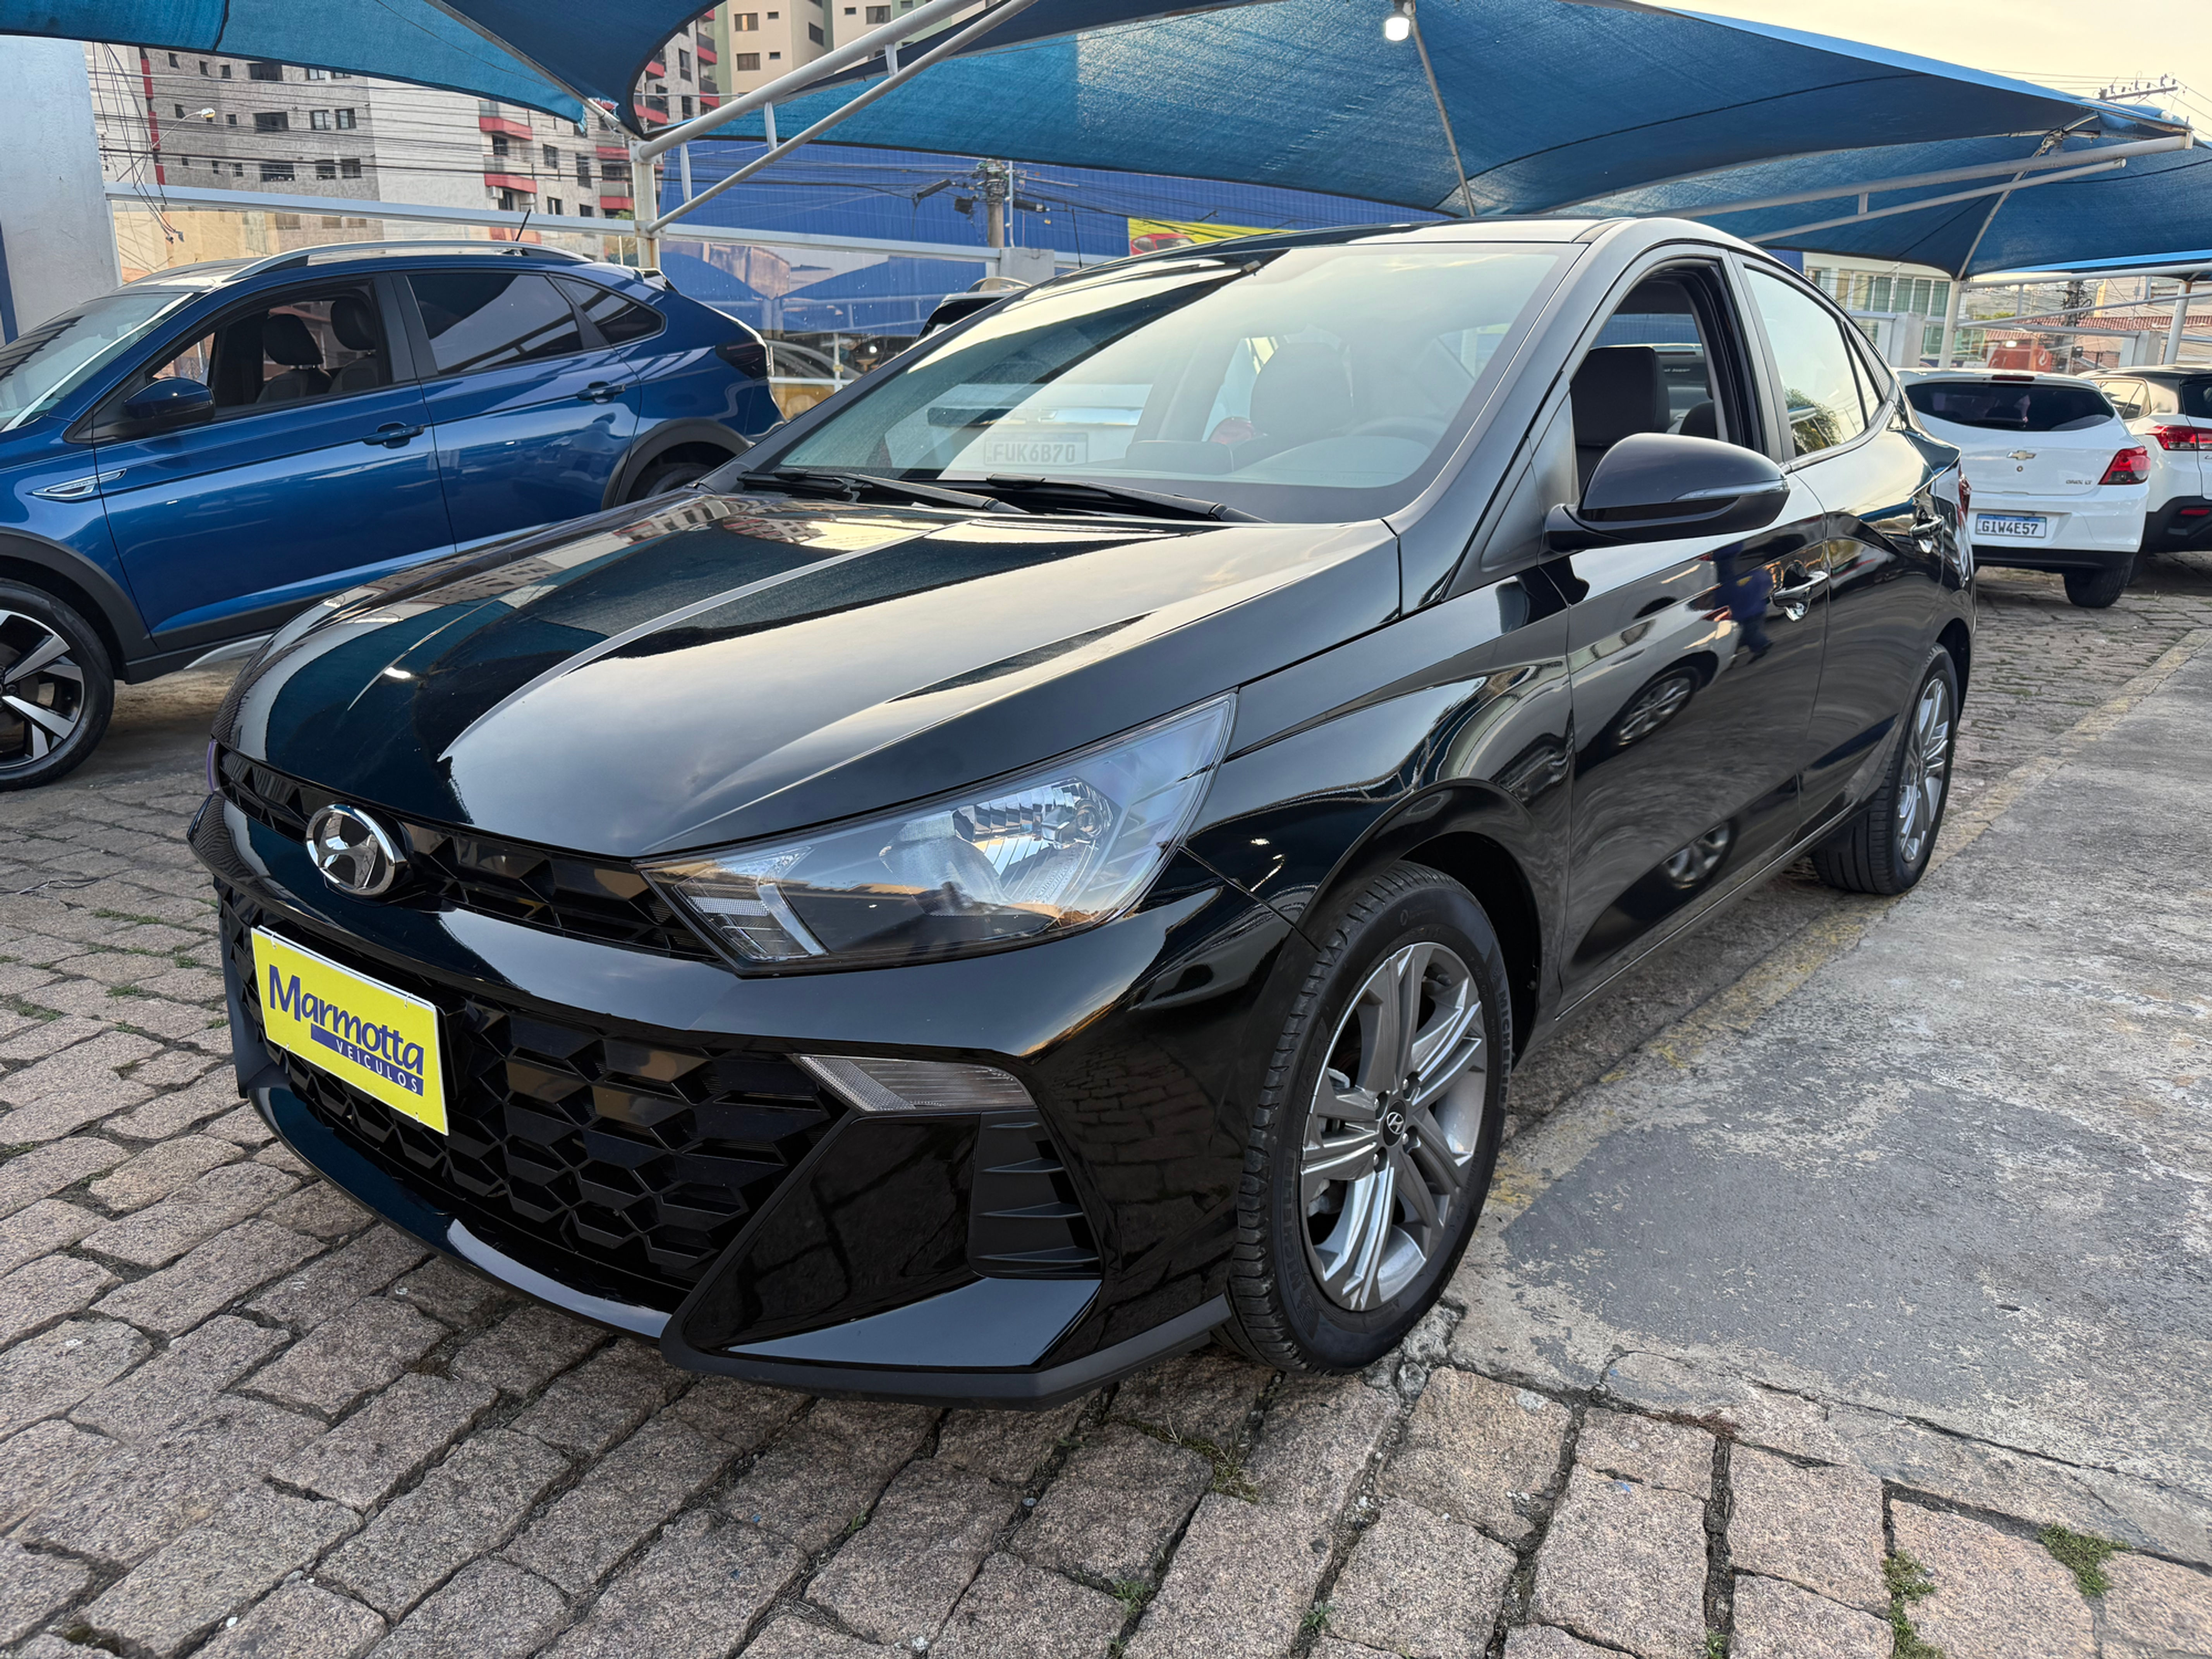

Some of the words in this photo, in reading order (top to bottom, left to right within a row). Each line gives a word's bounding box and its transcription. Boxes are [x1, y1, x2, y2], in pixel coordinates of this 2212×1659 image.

[993, 444, 1075, 463] FUK6B70
[1982, 521, 2039, 535] GIW4E57
[270, 964, 424, 1076] Marmotta
[1498, 986, 1511, 1103] MICHELIN
